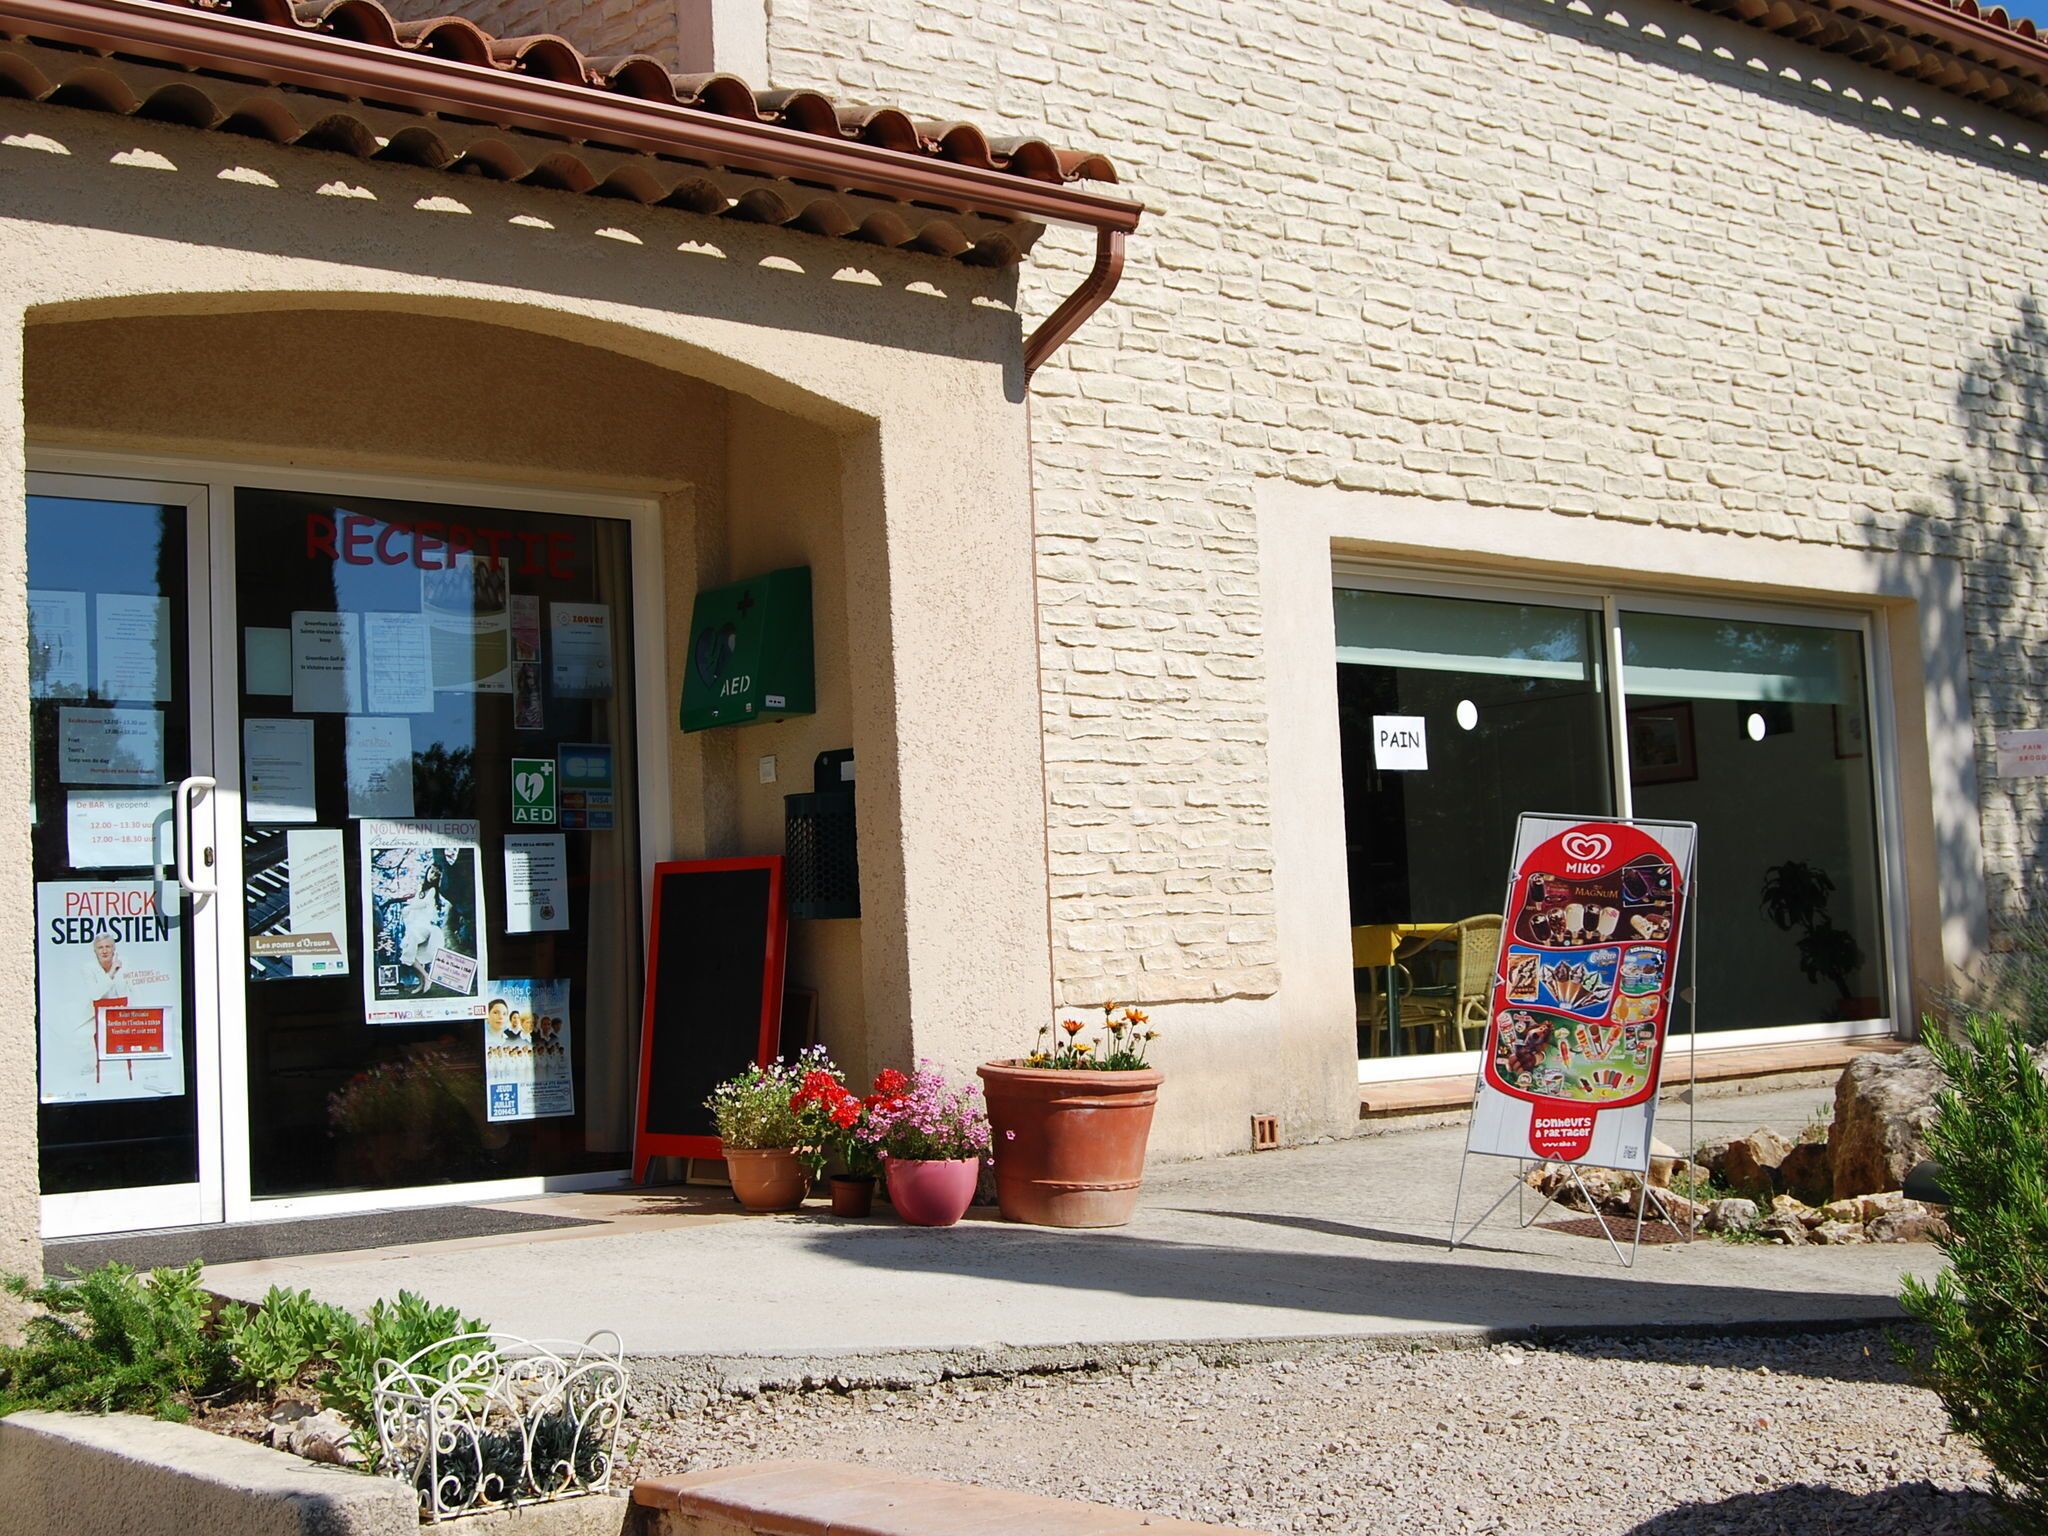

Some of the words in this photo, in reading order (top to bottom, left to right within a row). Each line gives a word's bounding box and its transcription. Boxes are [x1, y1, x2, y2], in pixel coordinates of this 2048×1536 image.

[305, 512, 577, 581] RECEPTIE
[720, 675, 750, 697] AED
[1380, 730, 1420, 748] PAIN
[76, 801, 87, 809] De
[89, 801, 105, 809] BAR
[108, 801, 114, 809] is
[116, 801, 151, 810] geopend:
[515, 808, 553, 822] AED
[90, 822, 112, 830] 12.00
[120, 821, 141, 829] 13.30
[370, 823, 433, 835] NOLWENN
[437, 823, 477, 835] LEROY
[92, 836, 113, 844] 17.00
[1565, 862, 1601, 875] MIKO
[1574, 886, 1619, 899] MAGNUM
[65, 891, 159, 917] PATRICK
[51, 915, 169, 945] SEBASTIEN
[499, 1093, 510, 1101] 12
[493, 1101, 516, 1109] JUILLET
[493, 1108, 517, 1117] 20H45
